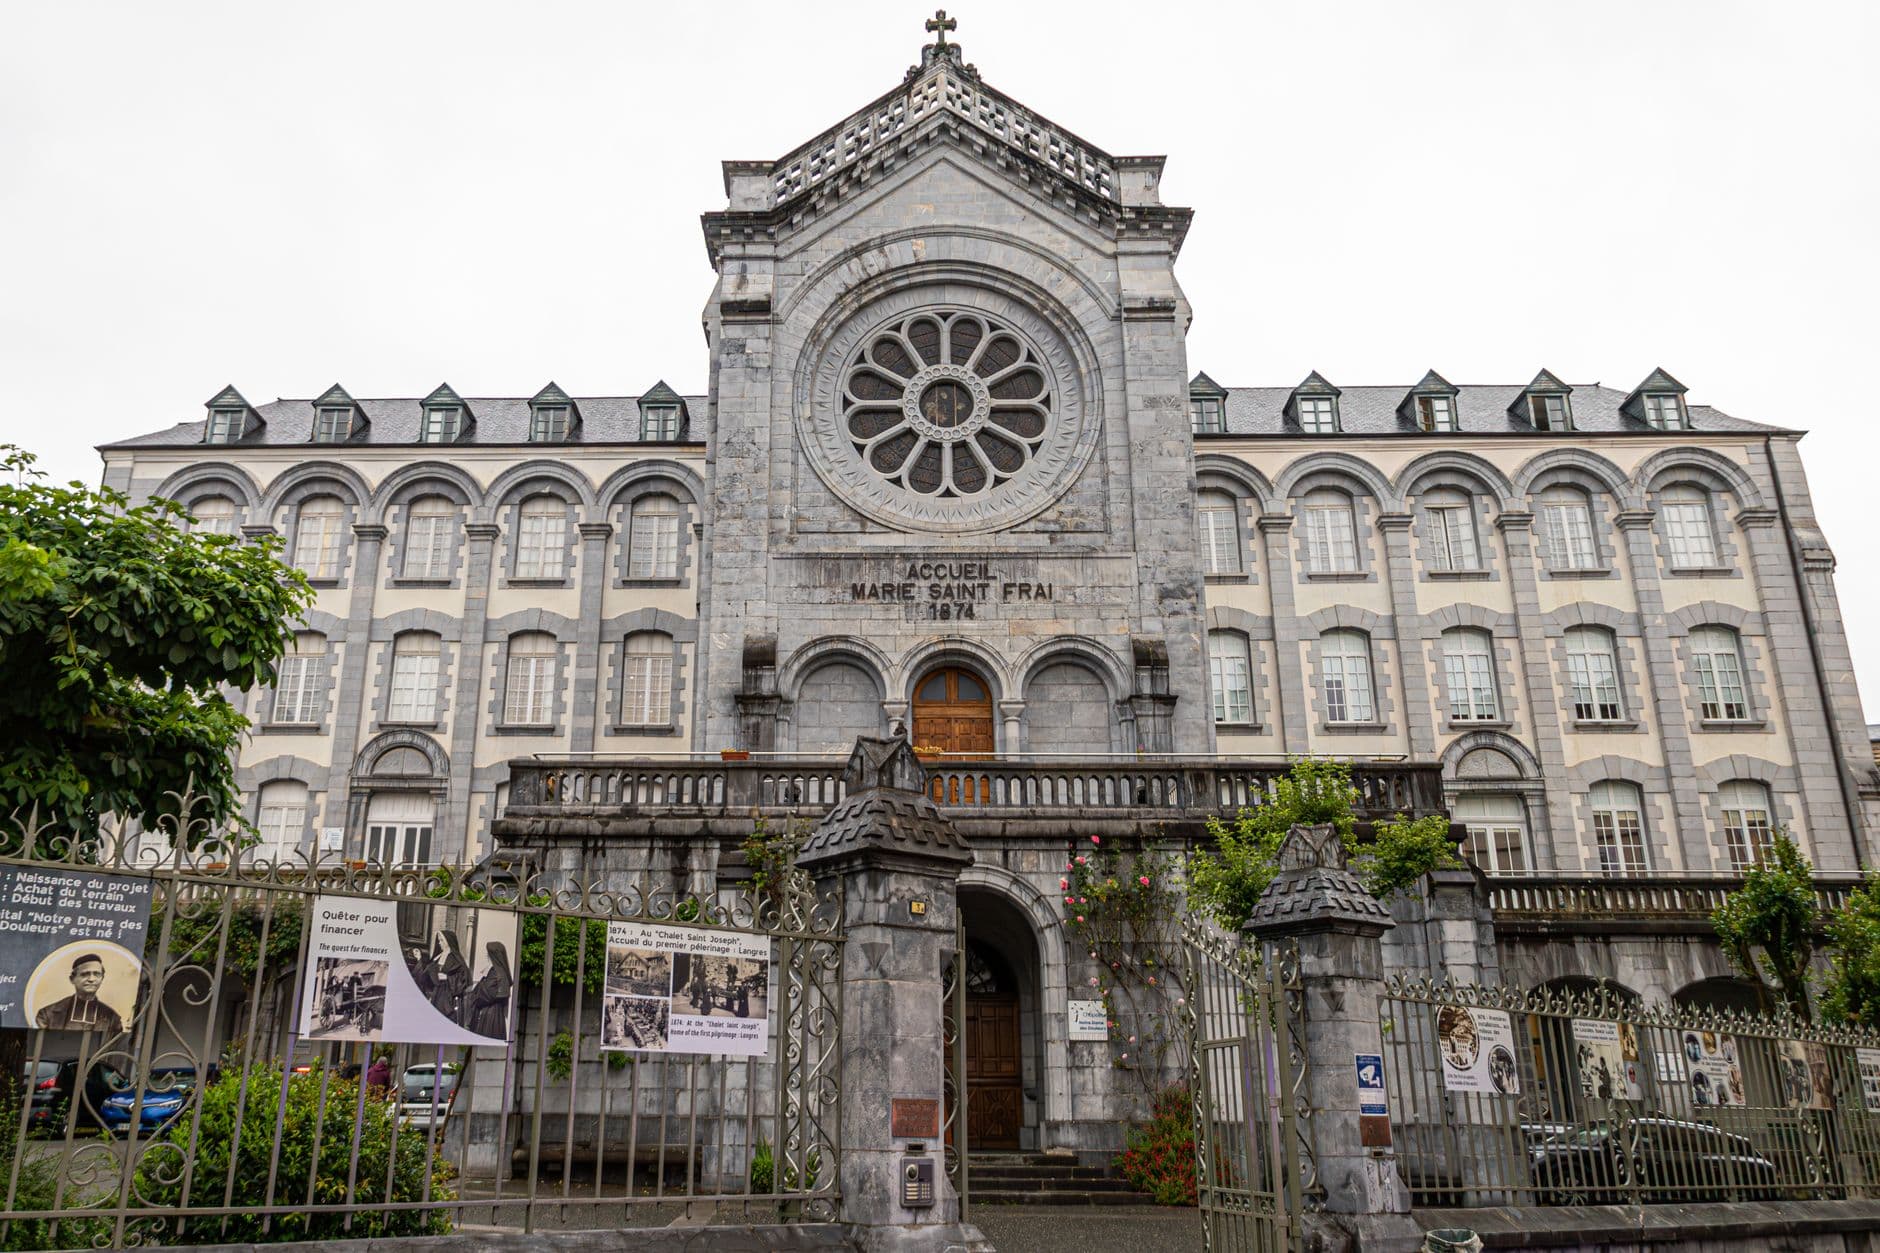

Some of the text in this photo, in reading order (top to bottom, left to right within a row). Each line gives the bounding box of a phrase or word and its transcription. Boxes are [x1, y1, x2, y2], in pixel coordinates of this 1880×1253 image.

[907, 563, 997, 580] ACCUEIL
[852, 583, 1053, 600] MARIE SAINT FRAI
[930, 603, 975, 620] 1874
[16, 872, 82, 887] Naissance
[87, 879, 104, 889] du
[108, 882, 149, 894] projet
[13, 883, 54, 895] Achat
[59, 887, 76, 897] du
[82, 889, 124, 902] terrain
[11, 893, 53, 906] Début
[58, 897, 82, 908] des
[88, 900, 136, 913] travaux
[77, 916, 114, 928] Dame
[120, 920, 143, 930] des
[322, 911, 389, 924] Quêter pour
[70, 928, 91, 937] est
[96, 928, 113, 939] né
[321, 925, 364, 935] financer
[640, 929, 652, 937] Au
[687, 933, 707, 942] Saint
[319, 943, 388, 954] The quest for finances
[608, 936, 640, 945] Accueil
[642, 938, 653, 947] du
[655, 940, 687, 950] premier
[738, 946, 768, 957] Langres
